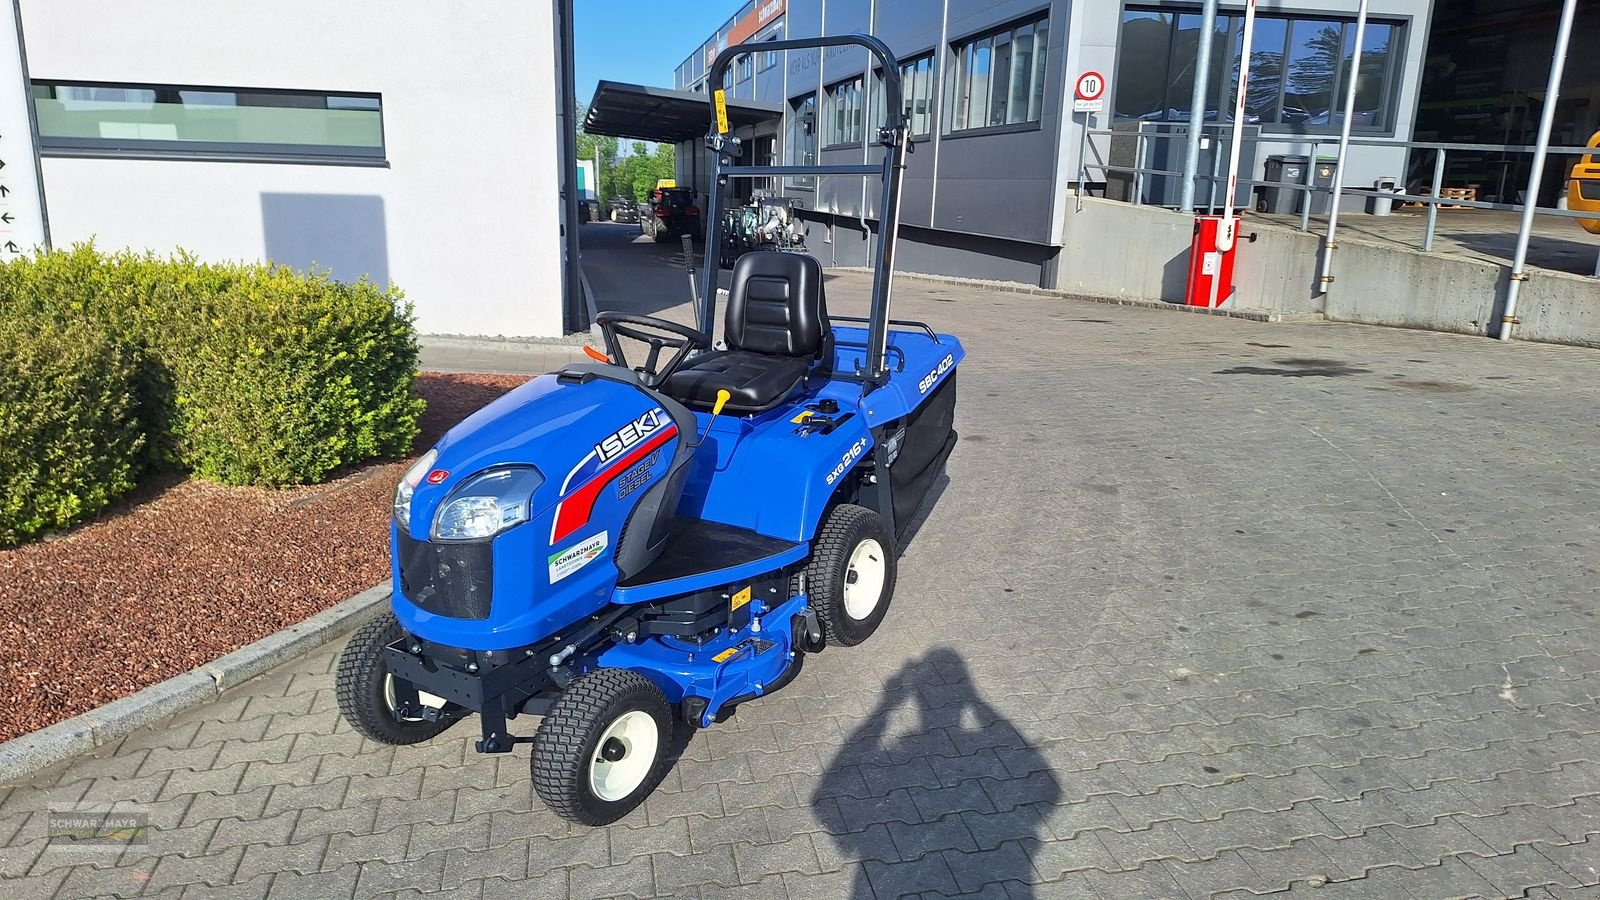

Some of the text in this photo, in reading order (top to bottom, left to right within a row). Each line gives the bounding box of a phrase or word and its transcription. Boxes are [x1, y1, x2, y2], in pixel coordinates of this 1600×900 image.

[1085, 80, 1096, 93] 10
[594, 408, 660, 464] ISEKI
[618, 471, 653, 501] DIESEL
[619, 461, 651, 489] STAGE
[554, 540, 600, 567] SCHWARZMAYR
